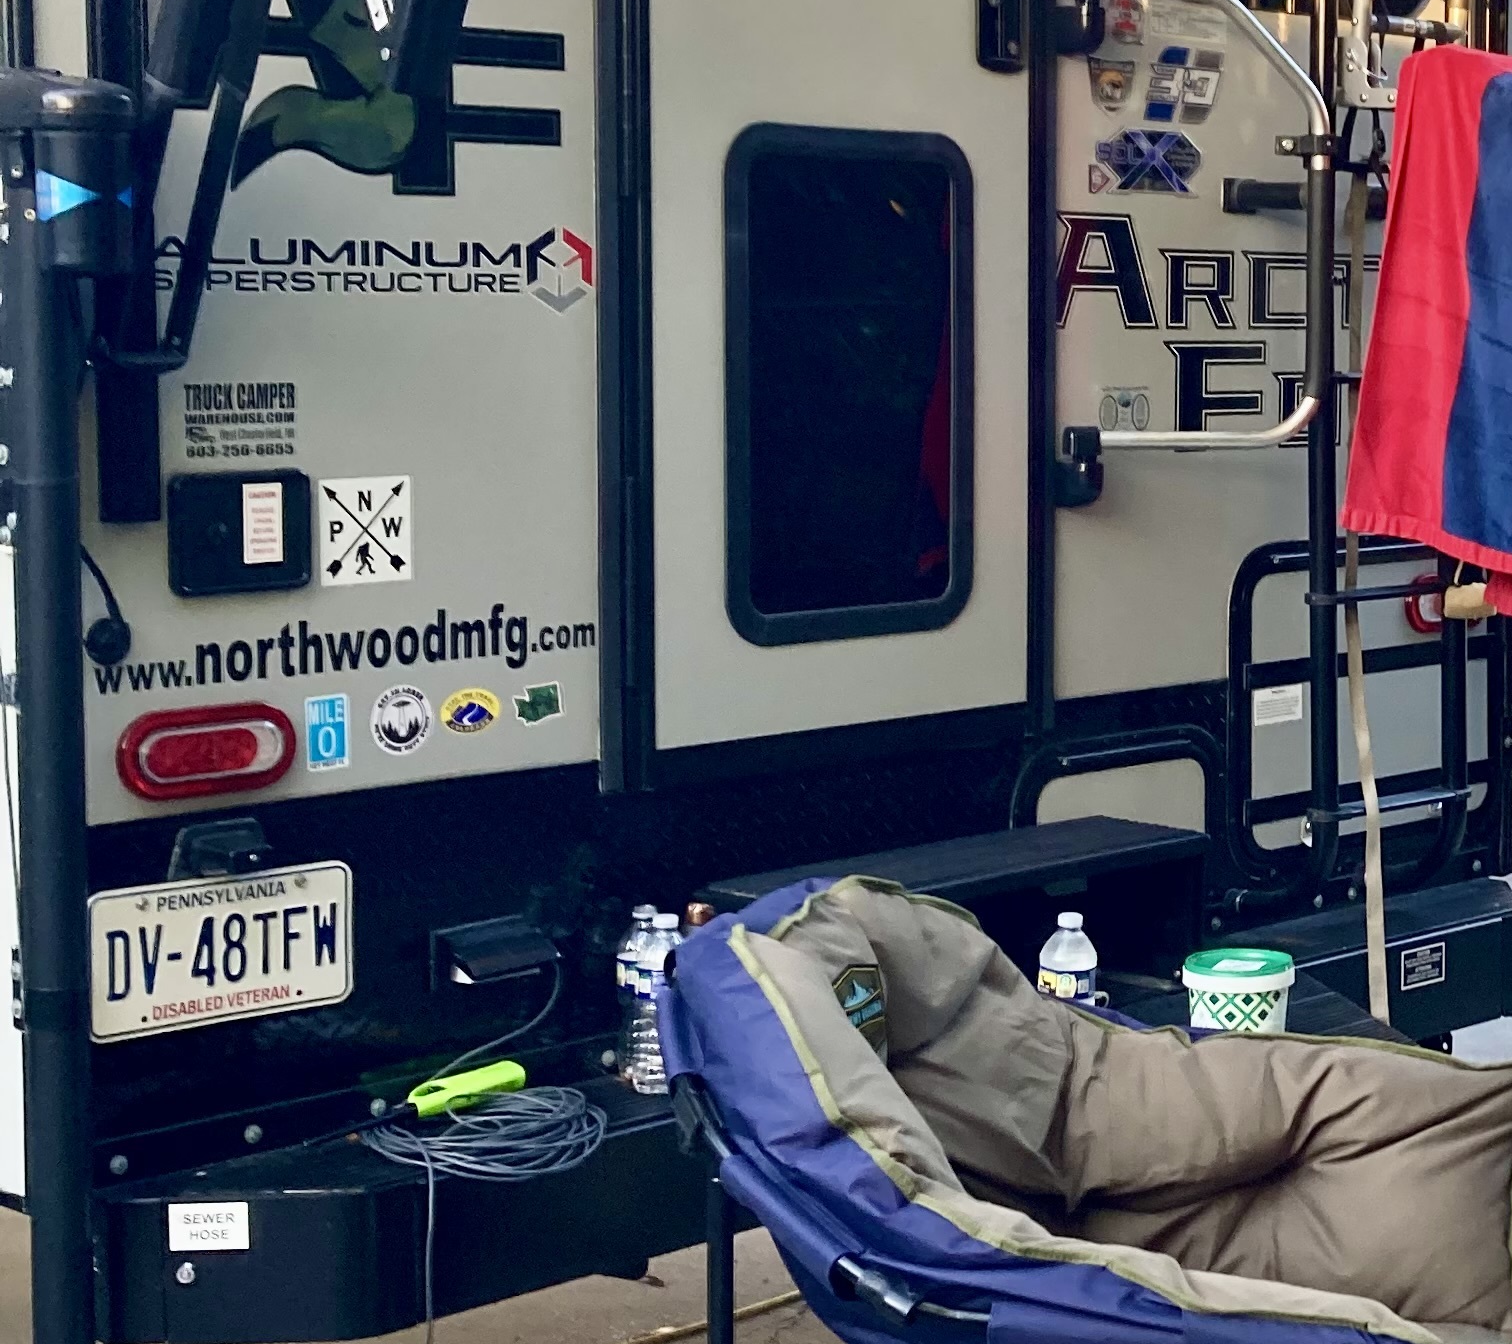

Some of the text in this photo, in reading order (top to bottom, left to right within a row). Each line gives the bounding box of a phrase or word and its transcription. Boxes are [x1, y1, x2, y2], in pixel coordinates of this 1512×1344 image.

[154, 269, 521, 294] SPERSTRUCTURE
[184, 382, 295, 411] TRUCK CAMPER
[184, 412, 295, 424] WAREHOUSE.COM
[357, 490, 372, 512] N
[329, 516, 403, 542] P W
[94, 603, 597, 695] www.northwoodmfg.com
[308, 698, 344, 725] MILE
[156, 880, 287, 912] PENNSYLVANIA
[106, 902, 337, 1002] DV-48TFW
[152, 984, 290, 1021] DISABLED VETERAN
[183, 1212, 235, 1225] SEWER
[189, 1229, 230, 1240] HOSE
